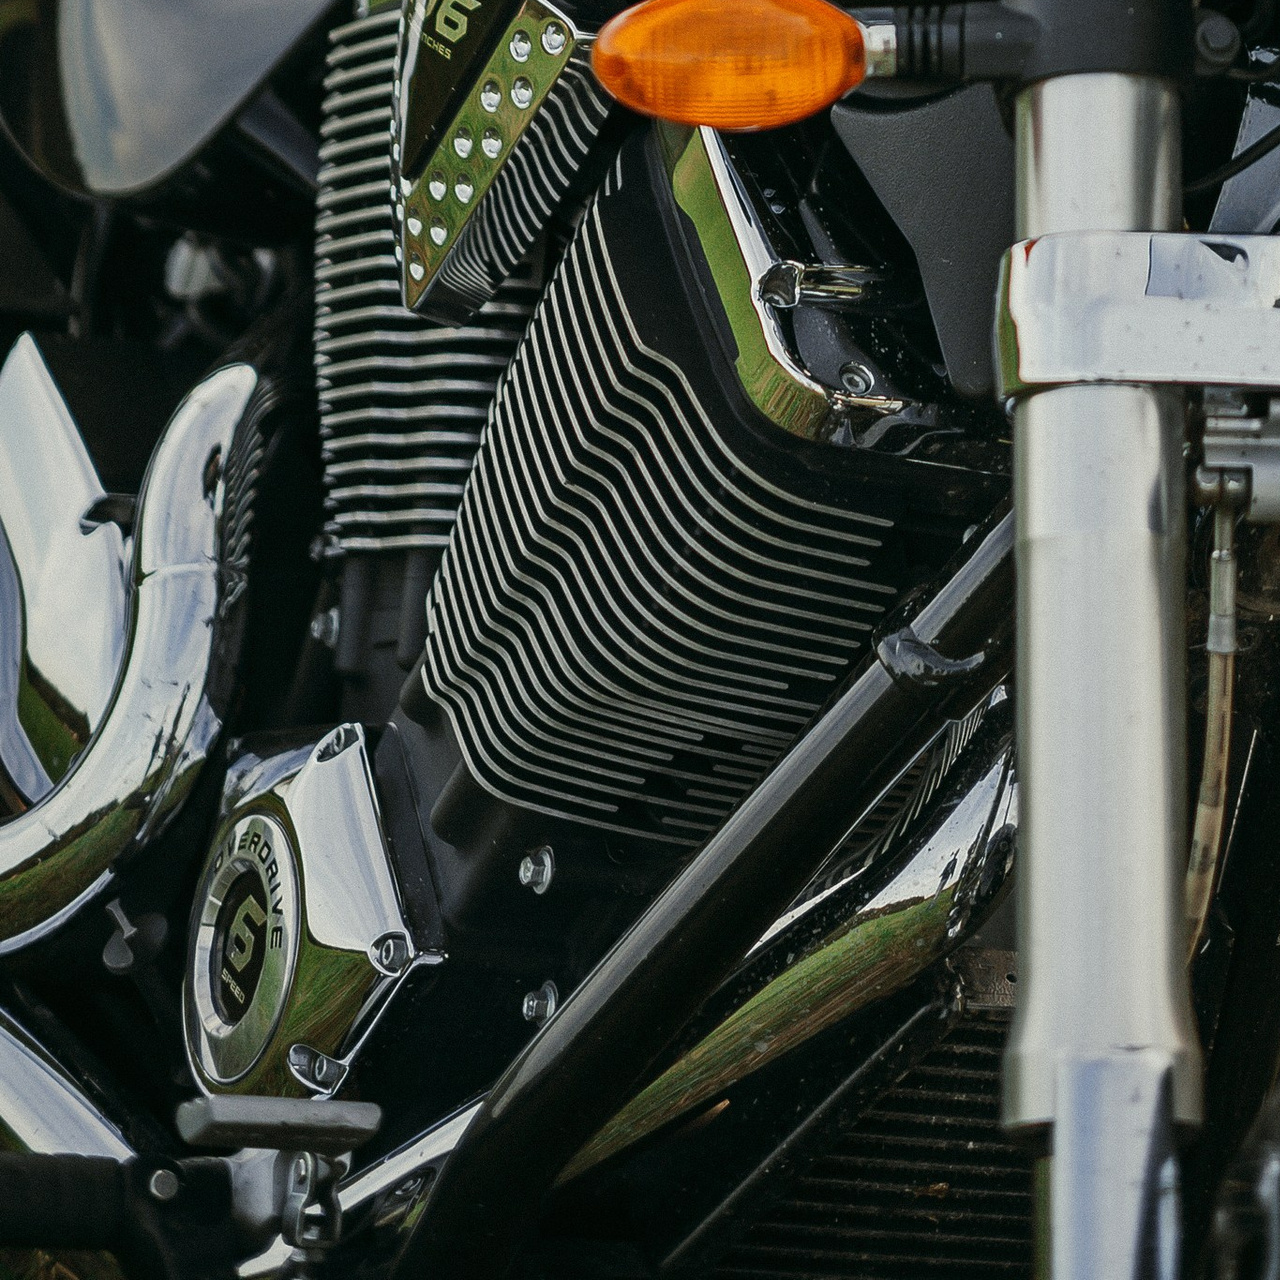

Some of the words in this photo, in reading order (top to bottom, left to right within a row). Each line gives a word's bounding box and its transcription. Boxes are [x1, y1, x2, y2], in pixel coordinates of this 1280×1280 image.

[214, 831, 284, 949] OVERDRIVE
[225, 894, 267, 973] 6
[221, 967, 245, 1004] SPEED
